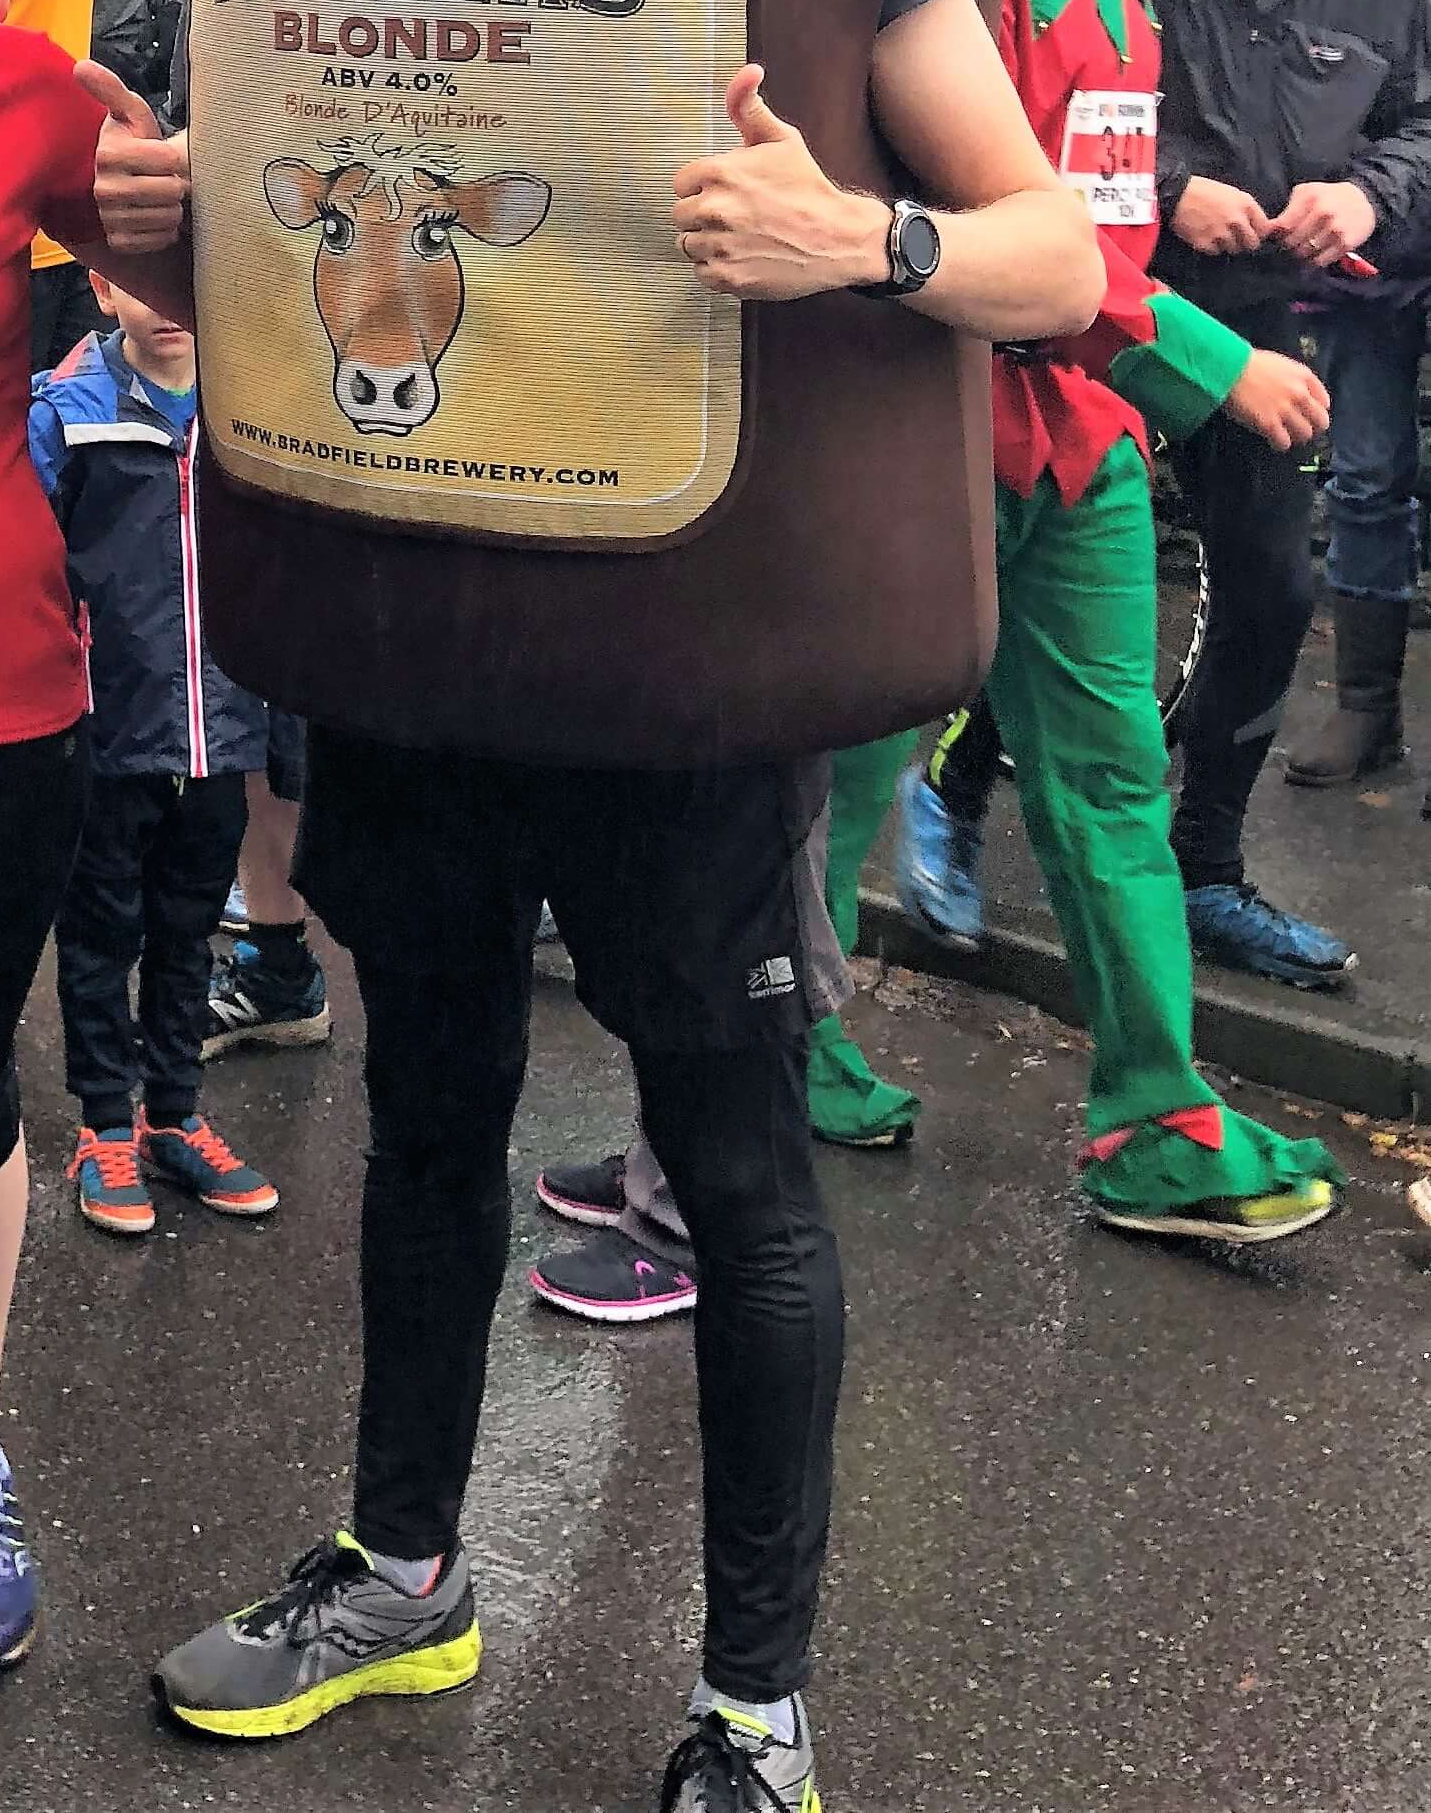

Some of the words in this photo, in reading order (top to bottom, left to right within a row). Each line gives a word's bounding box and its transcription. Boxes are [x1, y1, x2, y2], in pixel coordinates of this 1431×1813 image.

[272, 11, 532, 65] BLONDE
[321, 67, 375, 88] ABV
[385, 72, 458, 97] 4.0%
[285, 91, 350, 120] Blonde
[363, 100, 508, 137] D'Aquitaine
[231, 419, 620, 486] WWW.BRADFIELDBREWERY.COM
